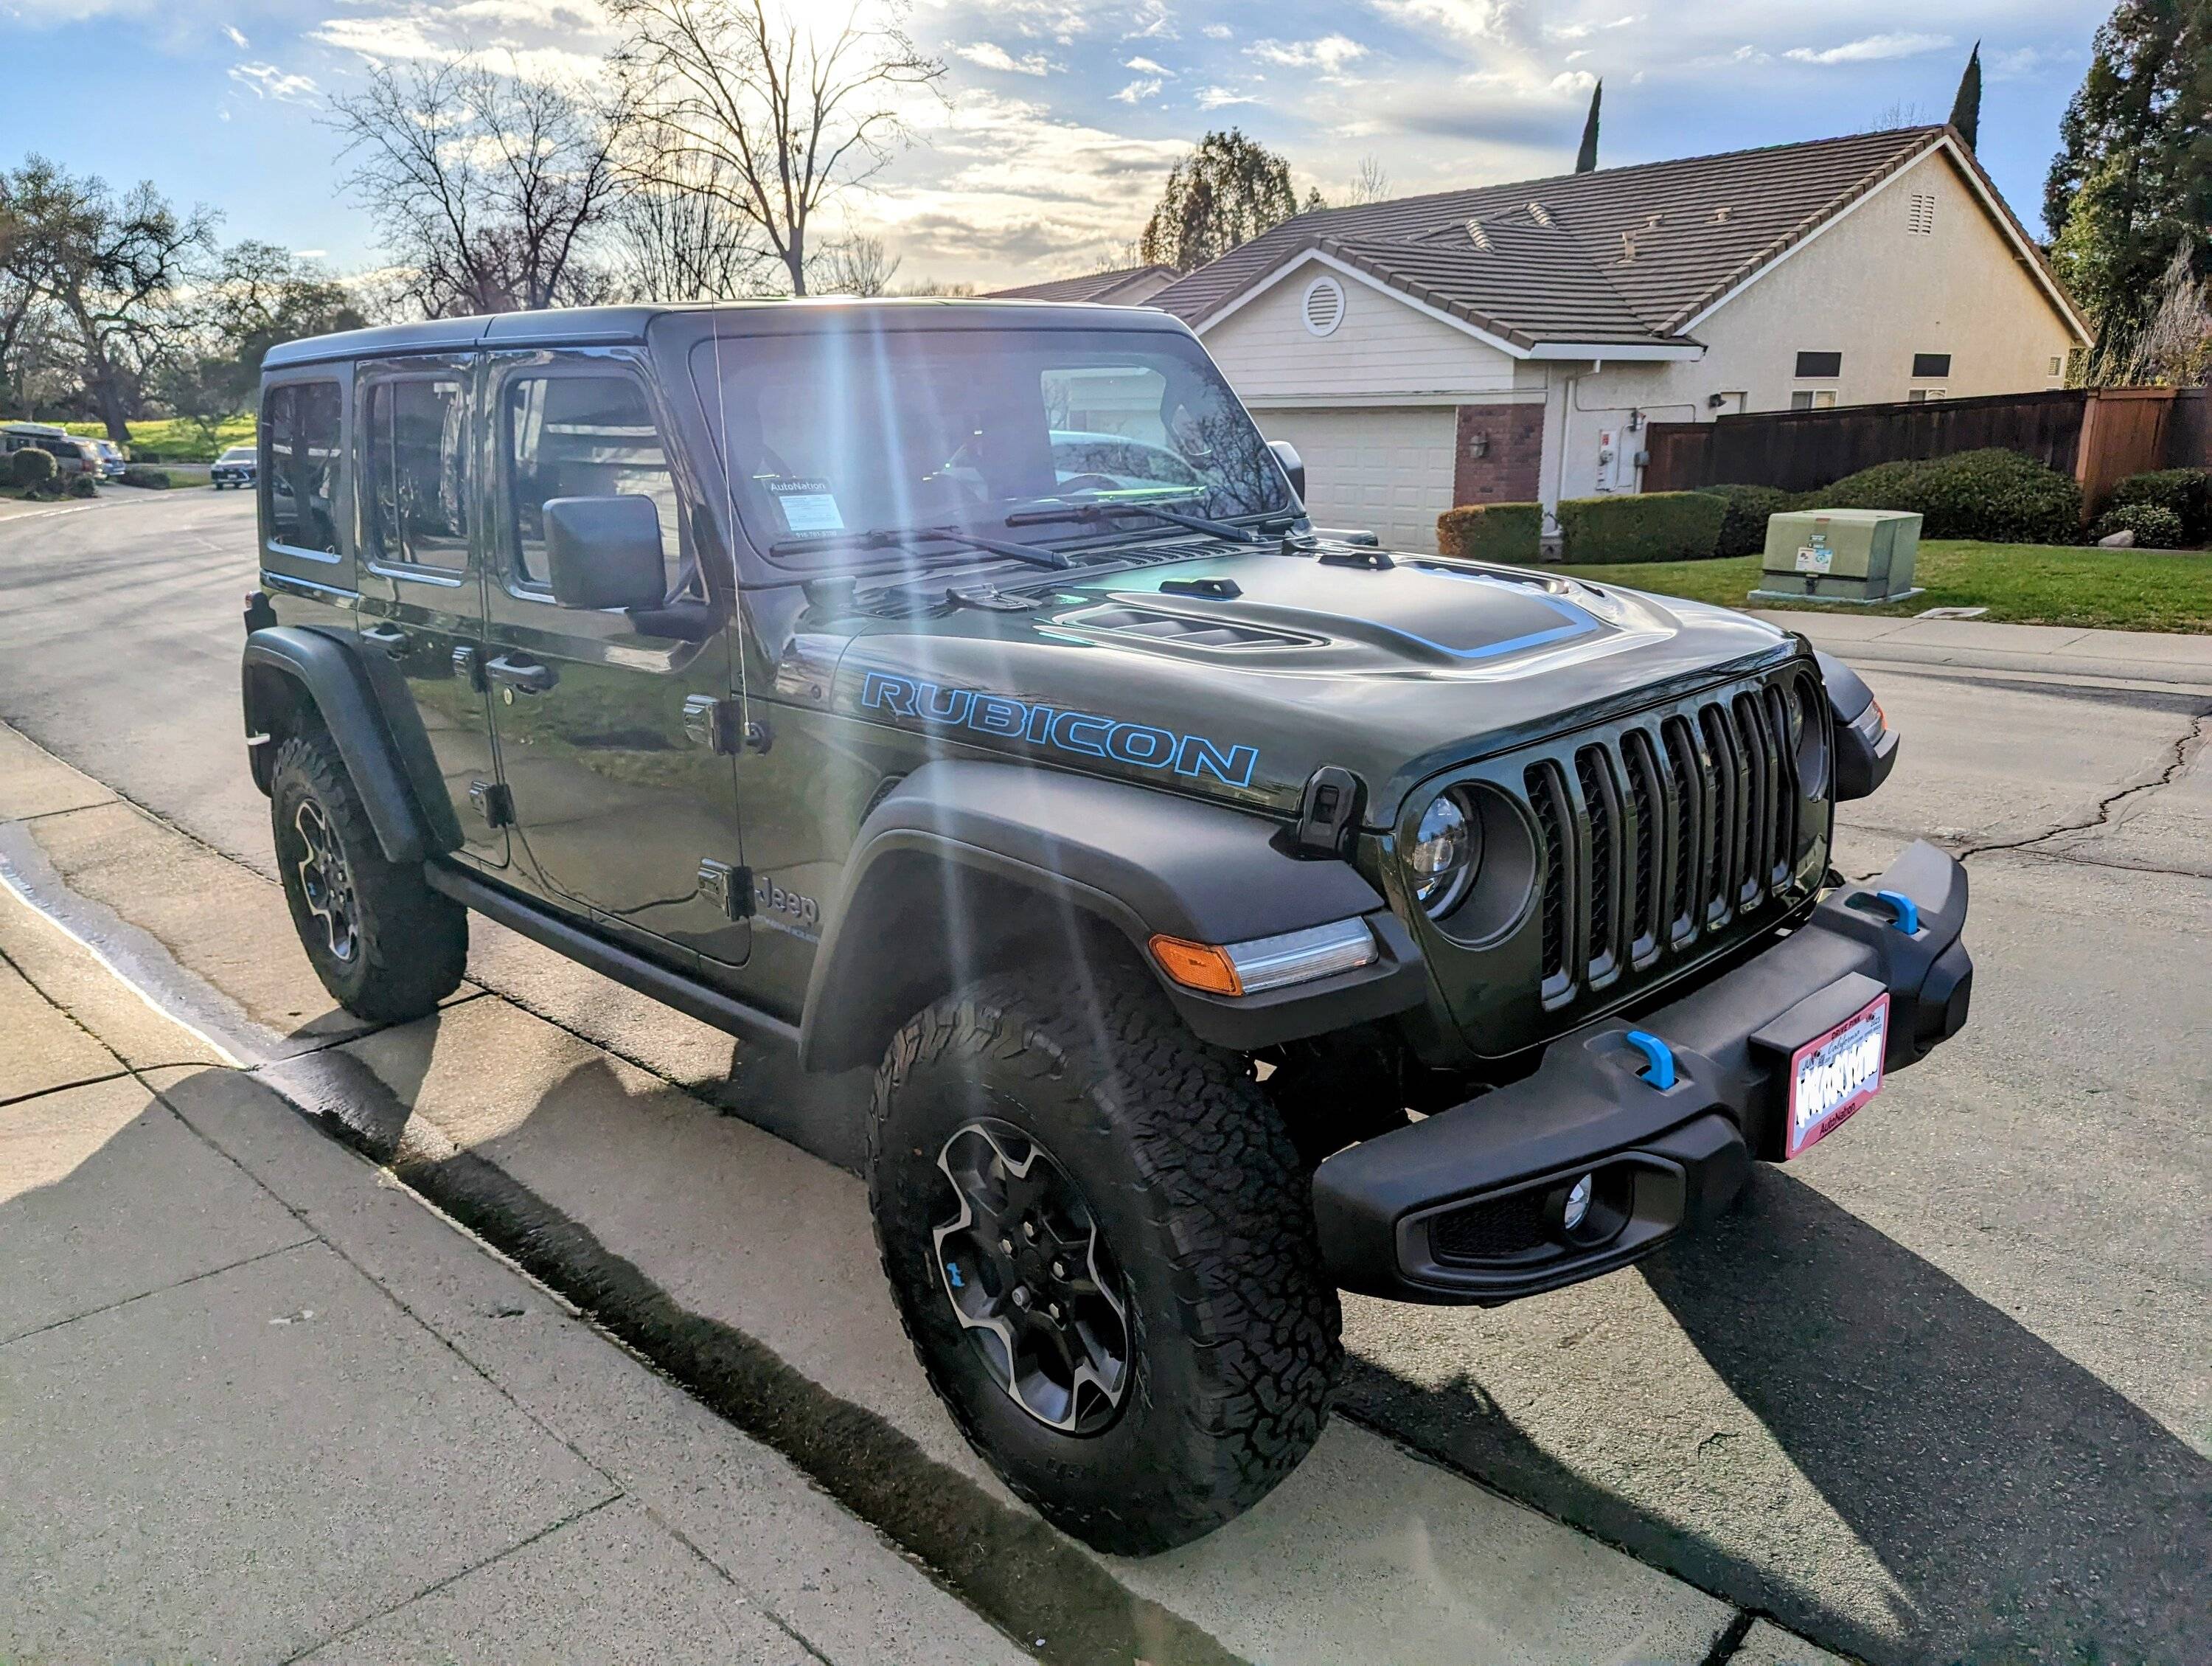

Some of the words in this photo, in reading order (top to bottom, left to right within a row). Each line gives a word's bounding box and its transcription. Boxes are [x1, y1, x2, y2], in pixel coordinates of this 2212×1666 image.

[771, 482, 826, 491] AutoNation
[861, 672, 1259, 788] RUBICON
[754, 877, 820, 927] Jeep
[1828, 1030, 1860, 1055] California
[1832, 1023, 1848, 1040] DRIVE
[1819, 1102, 1856, 1136] AutoNation
